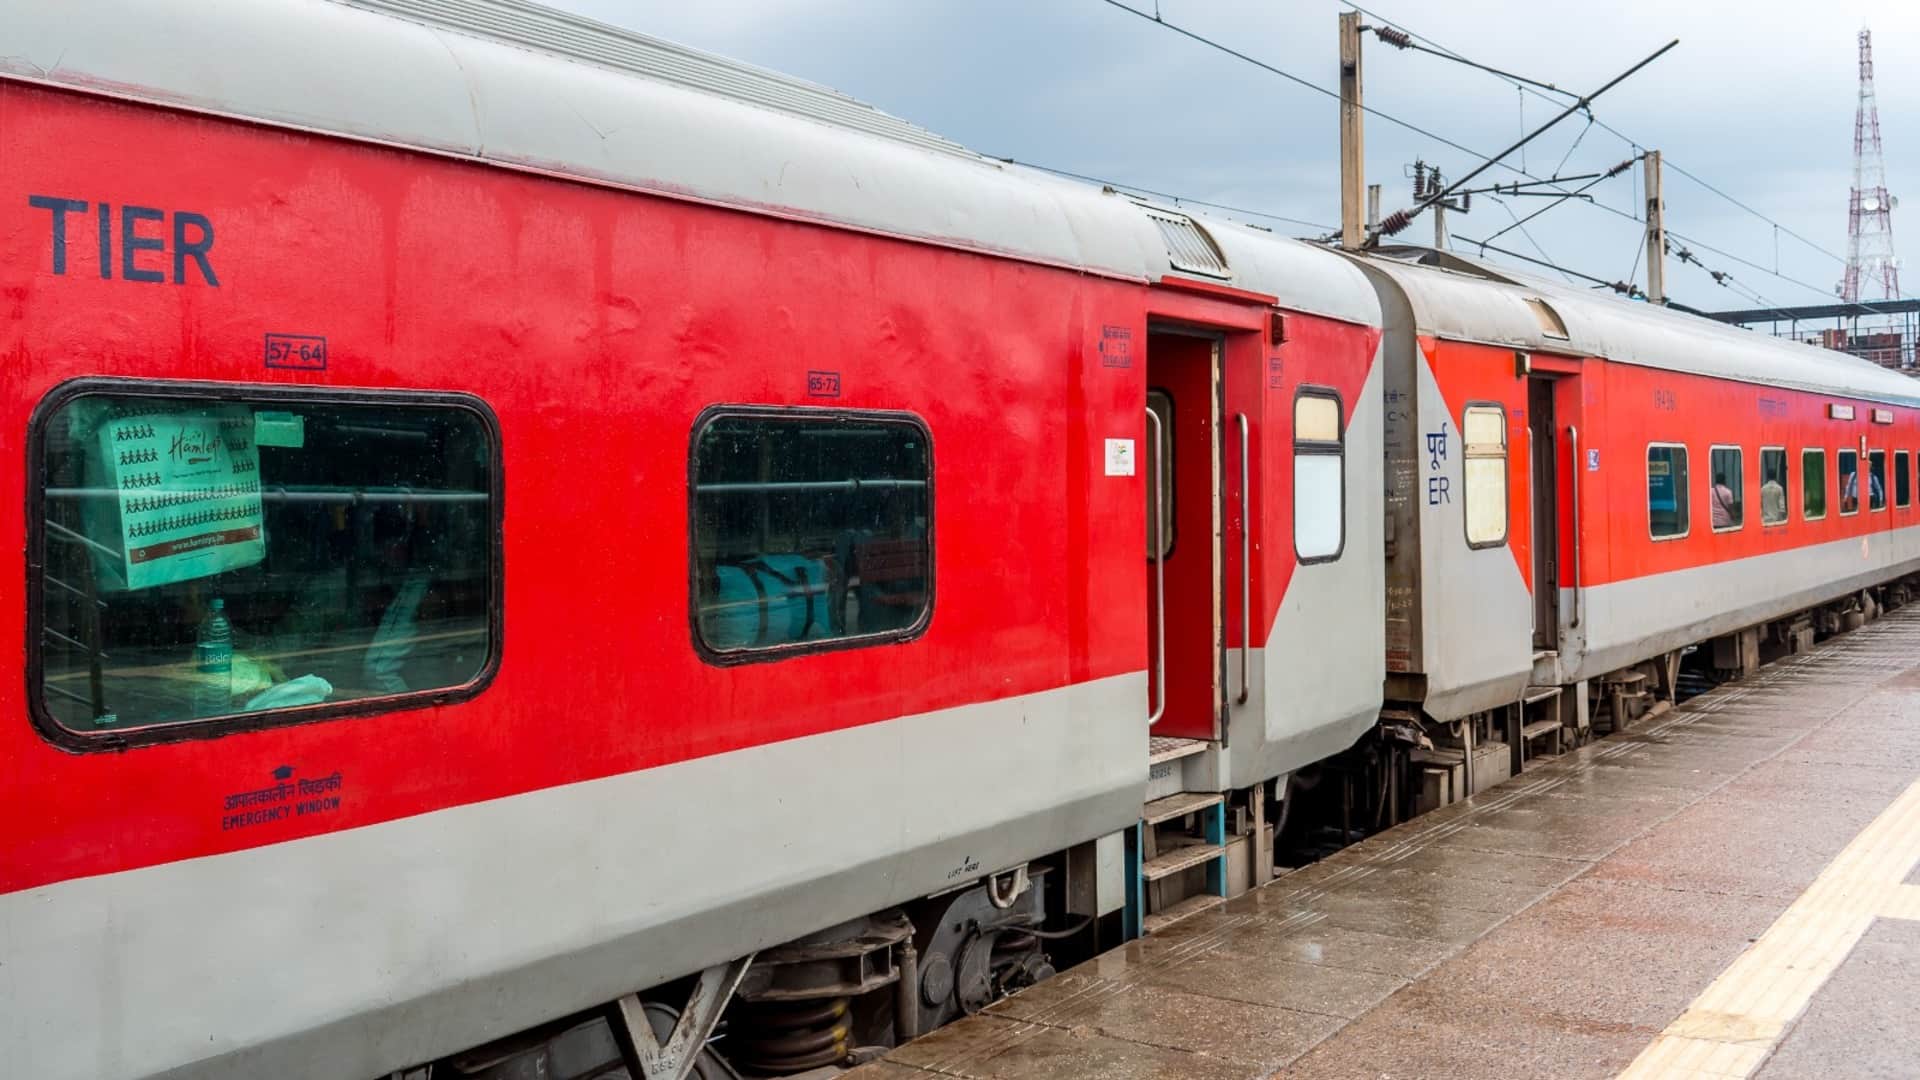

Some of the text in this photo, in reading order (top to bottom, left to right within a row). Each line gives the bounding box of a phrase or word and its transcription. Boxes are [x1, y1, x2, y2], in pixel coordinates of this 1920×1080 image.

[29, 195, 221, 287] TIER
[270, 342, 322, 362] 57-64
[810, 376, 838, 391] 65-72
[1427, 422, 1448, 470] पूर्व
[1429, 476, 1450, 505] ER
[222, 796, 341, 832] EMERGENCY WINDOW
